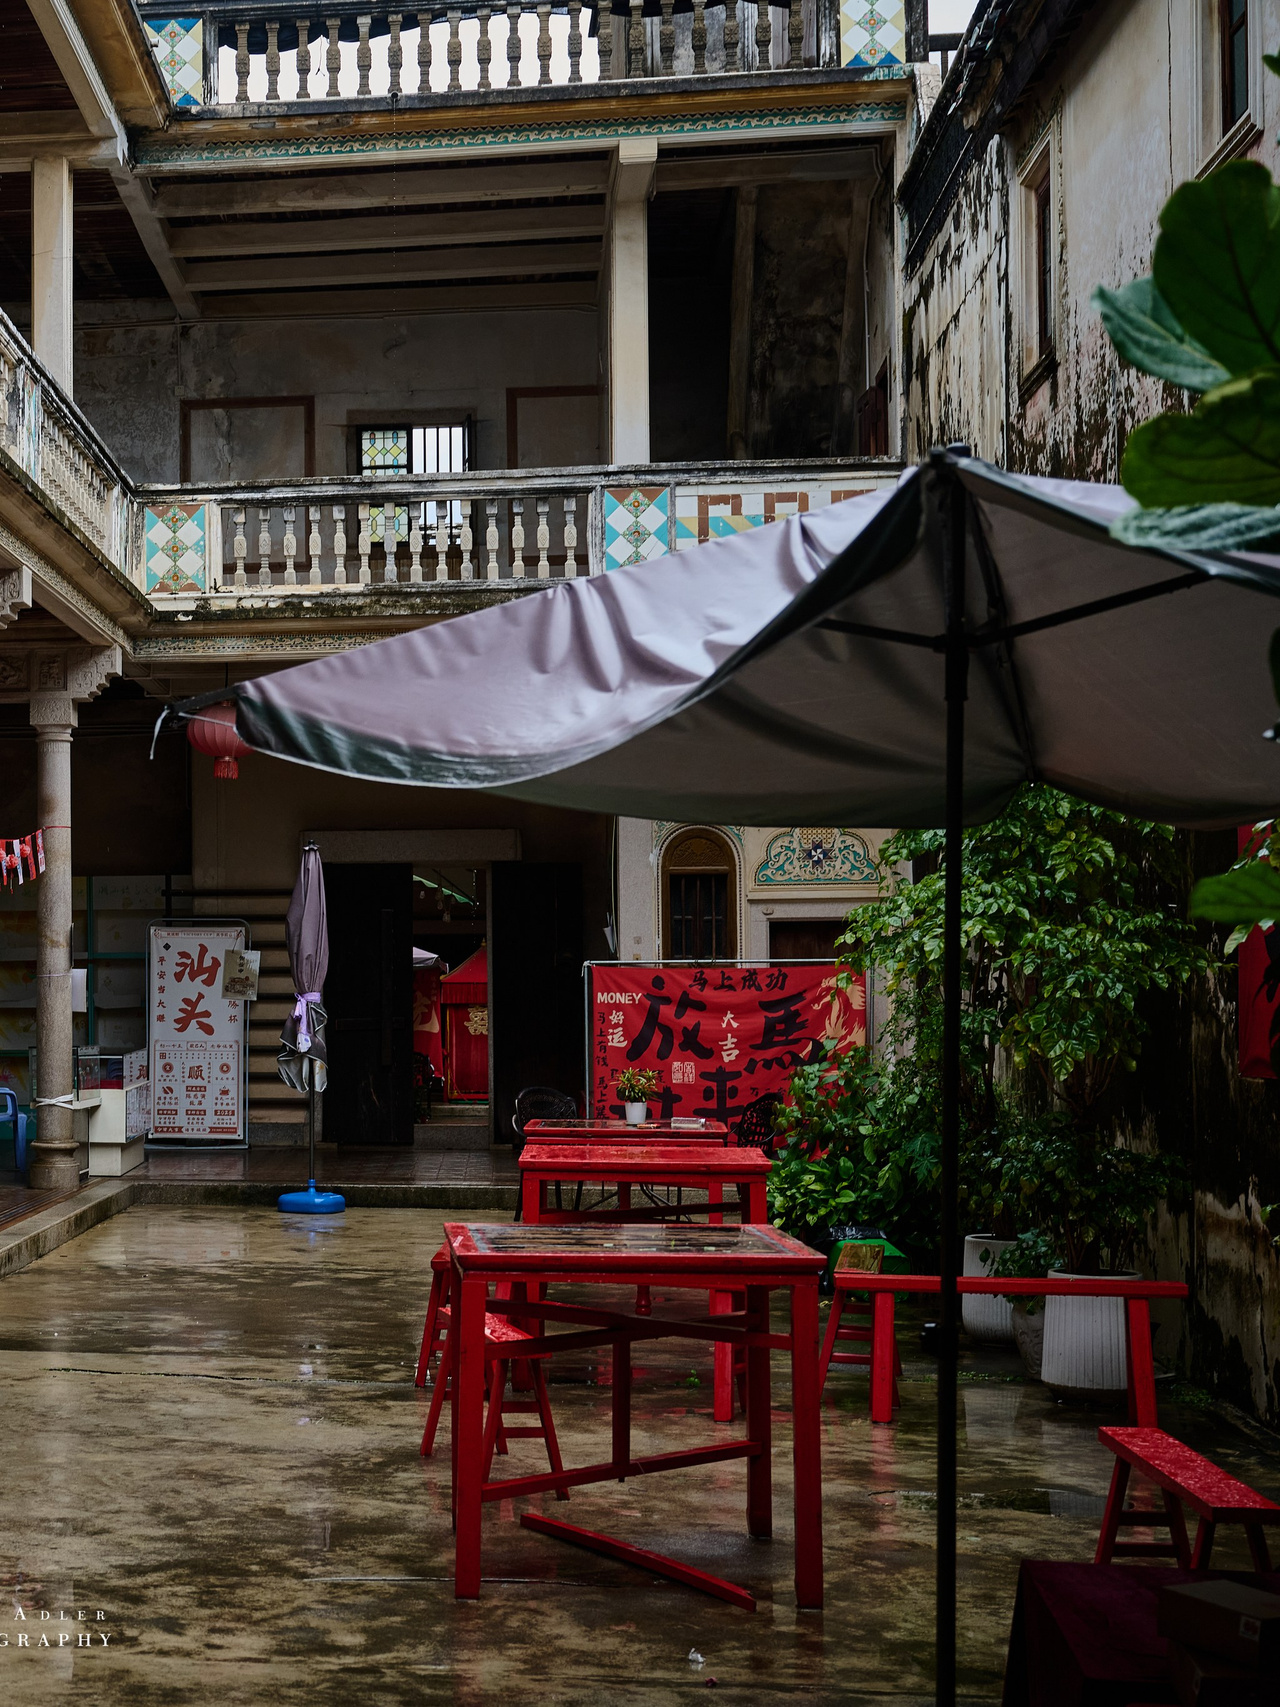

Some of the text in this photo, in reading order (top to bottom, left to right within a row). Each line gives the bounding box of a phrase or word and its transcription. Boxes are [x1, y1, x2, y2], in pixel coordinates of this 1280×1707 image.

[173, 943, 222, 1036] 汕头
[597, 992, 643, 1005] MONEY
[688, 968, 788, 992] 马上成功
[607, 1010, 628, 1048] 好运
[718, 1010, 740, 1062] 大吉
